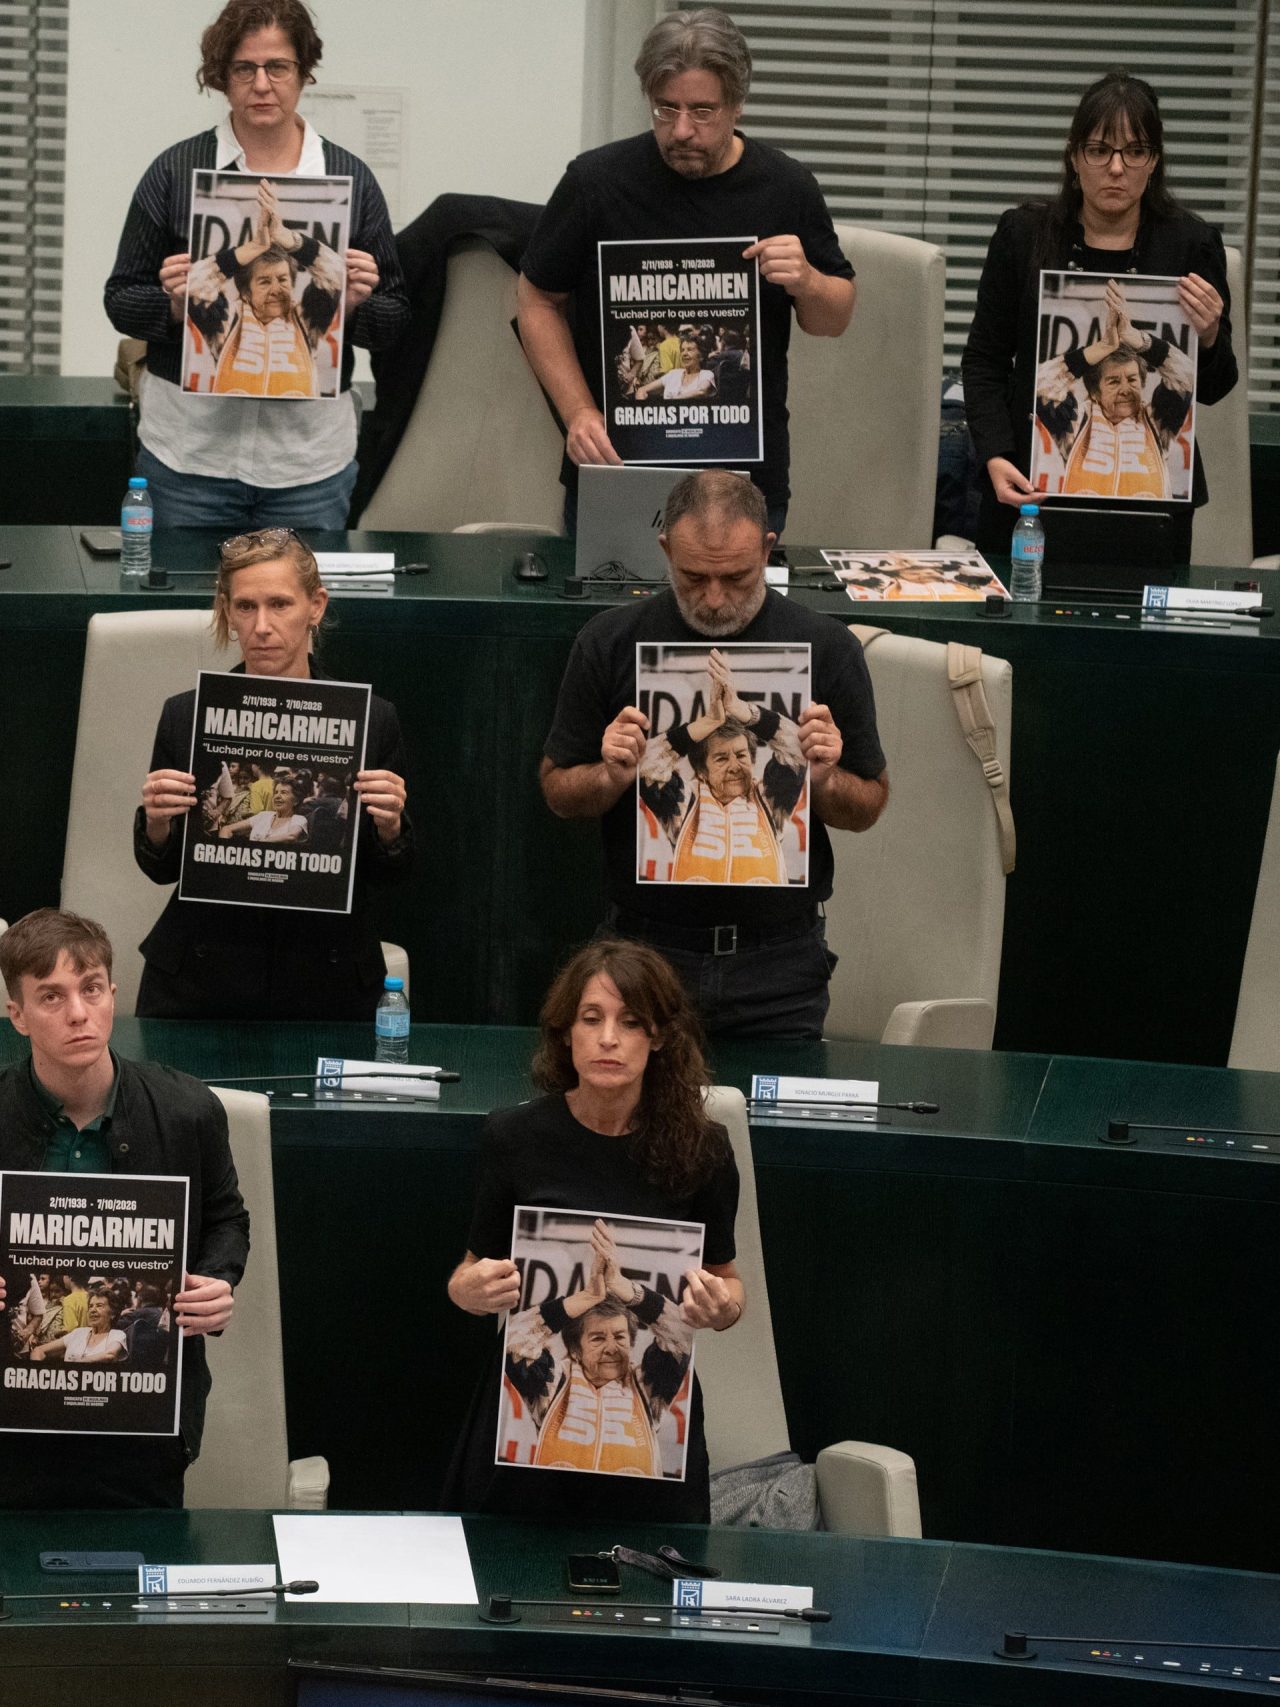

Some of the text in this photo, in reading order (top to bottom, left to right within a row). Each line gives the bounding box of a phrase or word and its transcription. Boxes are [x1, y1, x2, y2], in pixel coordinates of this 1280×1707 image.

[610, 272, 748, 301] MARICARMEN
[650, 311, 666, 320] por
[668, 309, 676, 318] lo
[678, 310, 696, 320] que
[698, 310, 708, 318] es
[615, 405, 750, 425] GRACIAS POR TODO
[204, 706, 356, 747] MARICARMEN
[245, 749, 262, 758] por
[264, 749, 274, 758] lo
[276, 752, 295, 762] que
[194, 843, 342, 874] GRACIAS POR TODO
[50, 1196, 87, 1210] 2/11/1938
[97, 1198, 137, 1212] 7/10/2026
[10, 1212, 175, 1249] MARICARMEN
[56, 1259, 75, 1270] por
[76, 1257, 86, 1268] lo
[88, 1260, 110, 1271] que
[112, 1260, 124, 1269] es
[4, 1367, 166, 1394] GRACIAS POR TODO
[207, 1576, 240, 1584] FERNÁNDEZ
[761, 1596, 788, 1604] ÁLVAREZ
